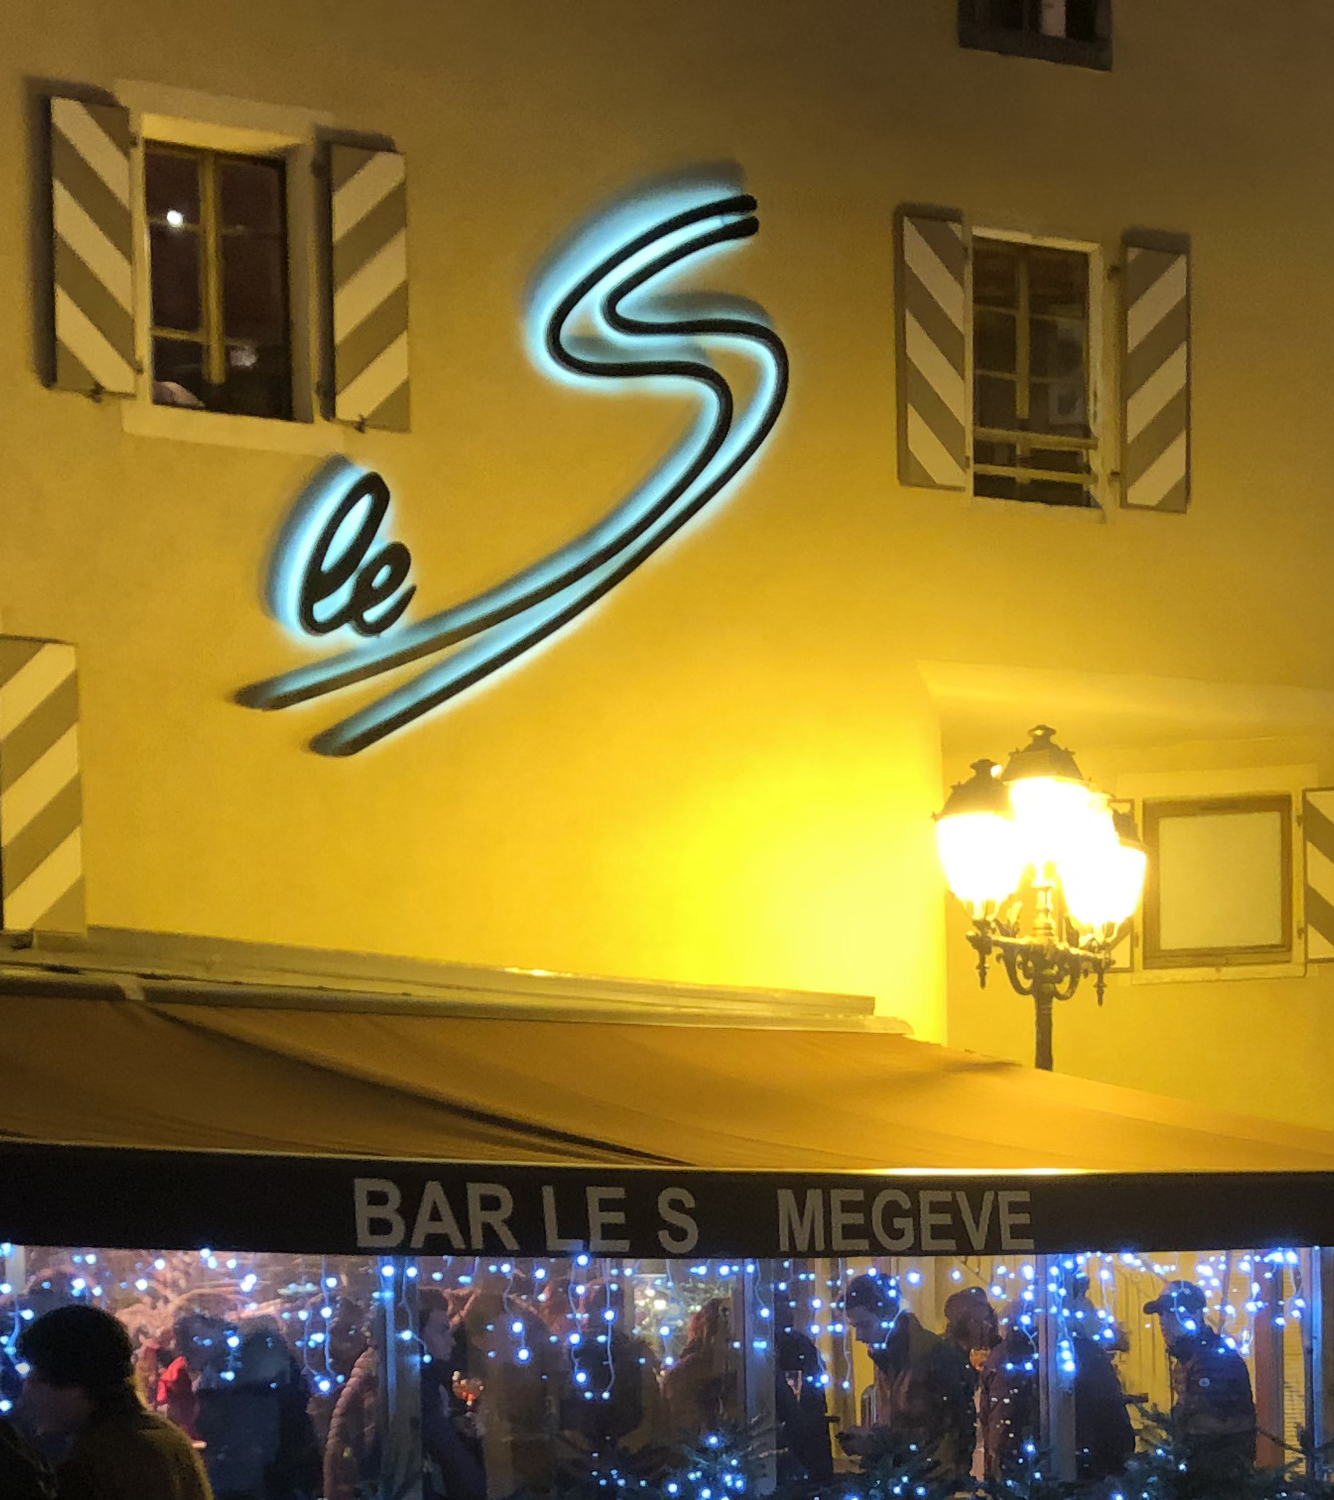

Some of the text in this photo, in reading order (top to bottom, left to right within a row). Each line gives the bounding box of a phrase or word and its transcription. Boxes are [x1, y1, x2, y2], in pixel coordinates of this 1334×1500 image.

[233, 195, 789, 758] le S
[353, 1177, 1035, 1254] BAR LE S MEGEVE
